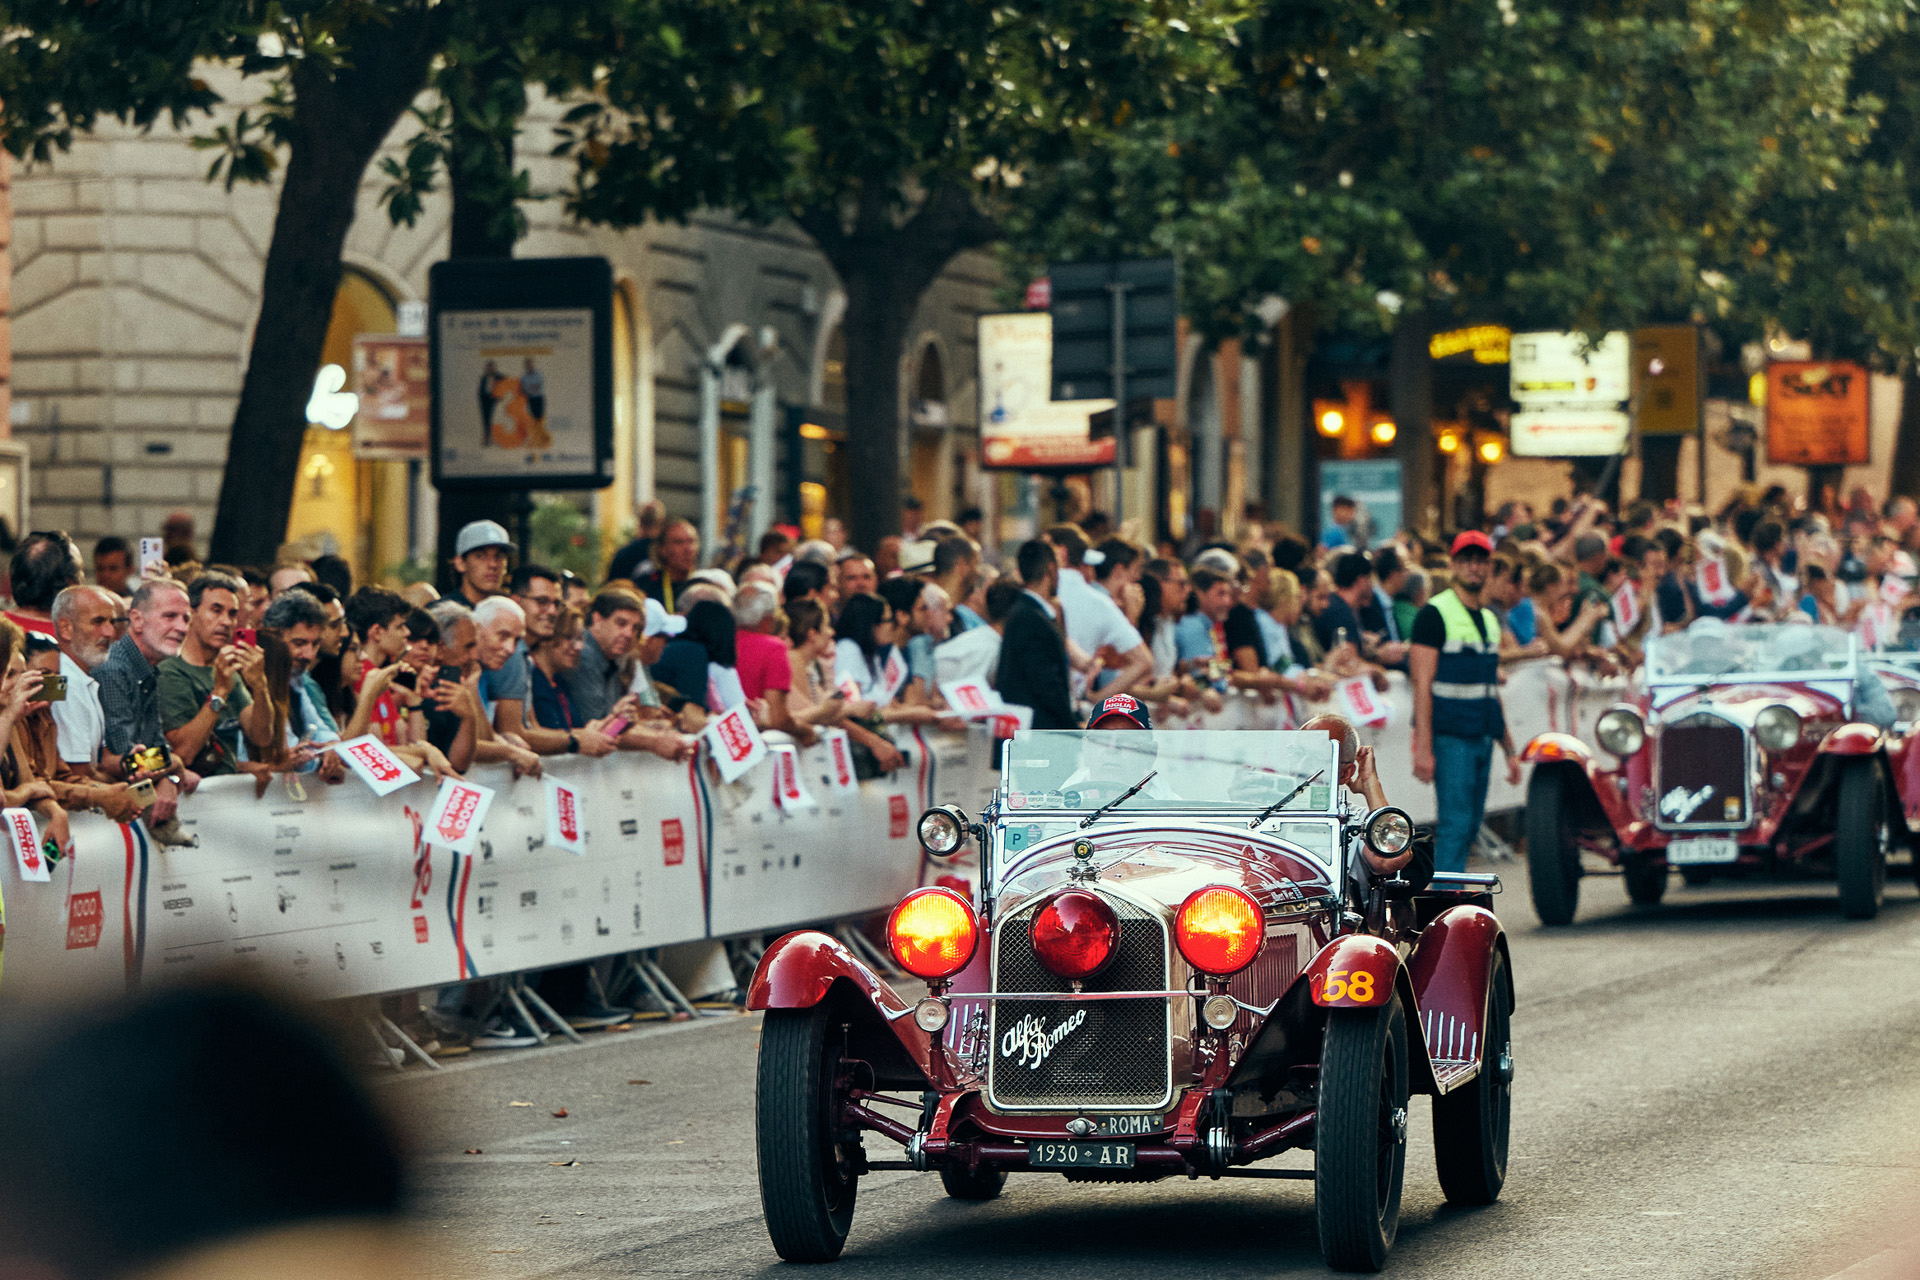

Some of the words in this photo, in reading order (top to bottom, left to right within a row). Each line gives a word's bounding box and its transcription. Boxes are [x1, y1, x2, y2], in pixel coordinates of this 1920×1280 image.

[351, 747, 387, 780] MIGLIA
[364, 744, 392, 772] 1000
[440, 786, 465, 828] MIGLIA
[454, 794, 478, 830] 1000
[1012, 833, 1022, 846] P
[73, 898, 97, 918] 1000
[68, 923, 97, 944] MIGLIA
[1322, 970, 1375, 1002] 58
[1001, 1013, 1046, 1066] Alfa
[1029, 1009, 1087, 1070] Romeo
[1109, 1116, 1152, 1134] ROMA
[1036, 1144, 1078, 1163] 1930
[1099, 1146, 1129, 1165] AR
